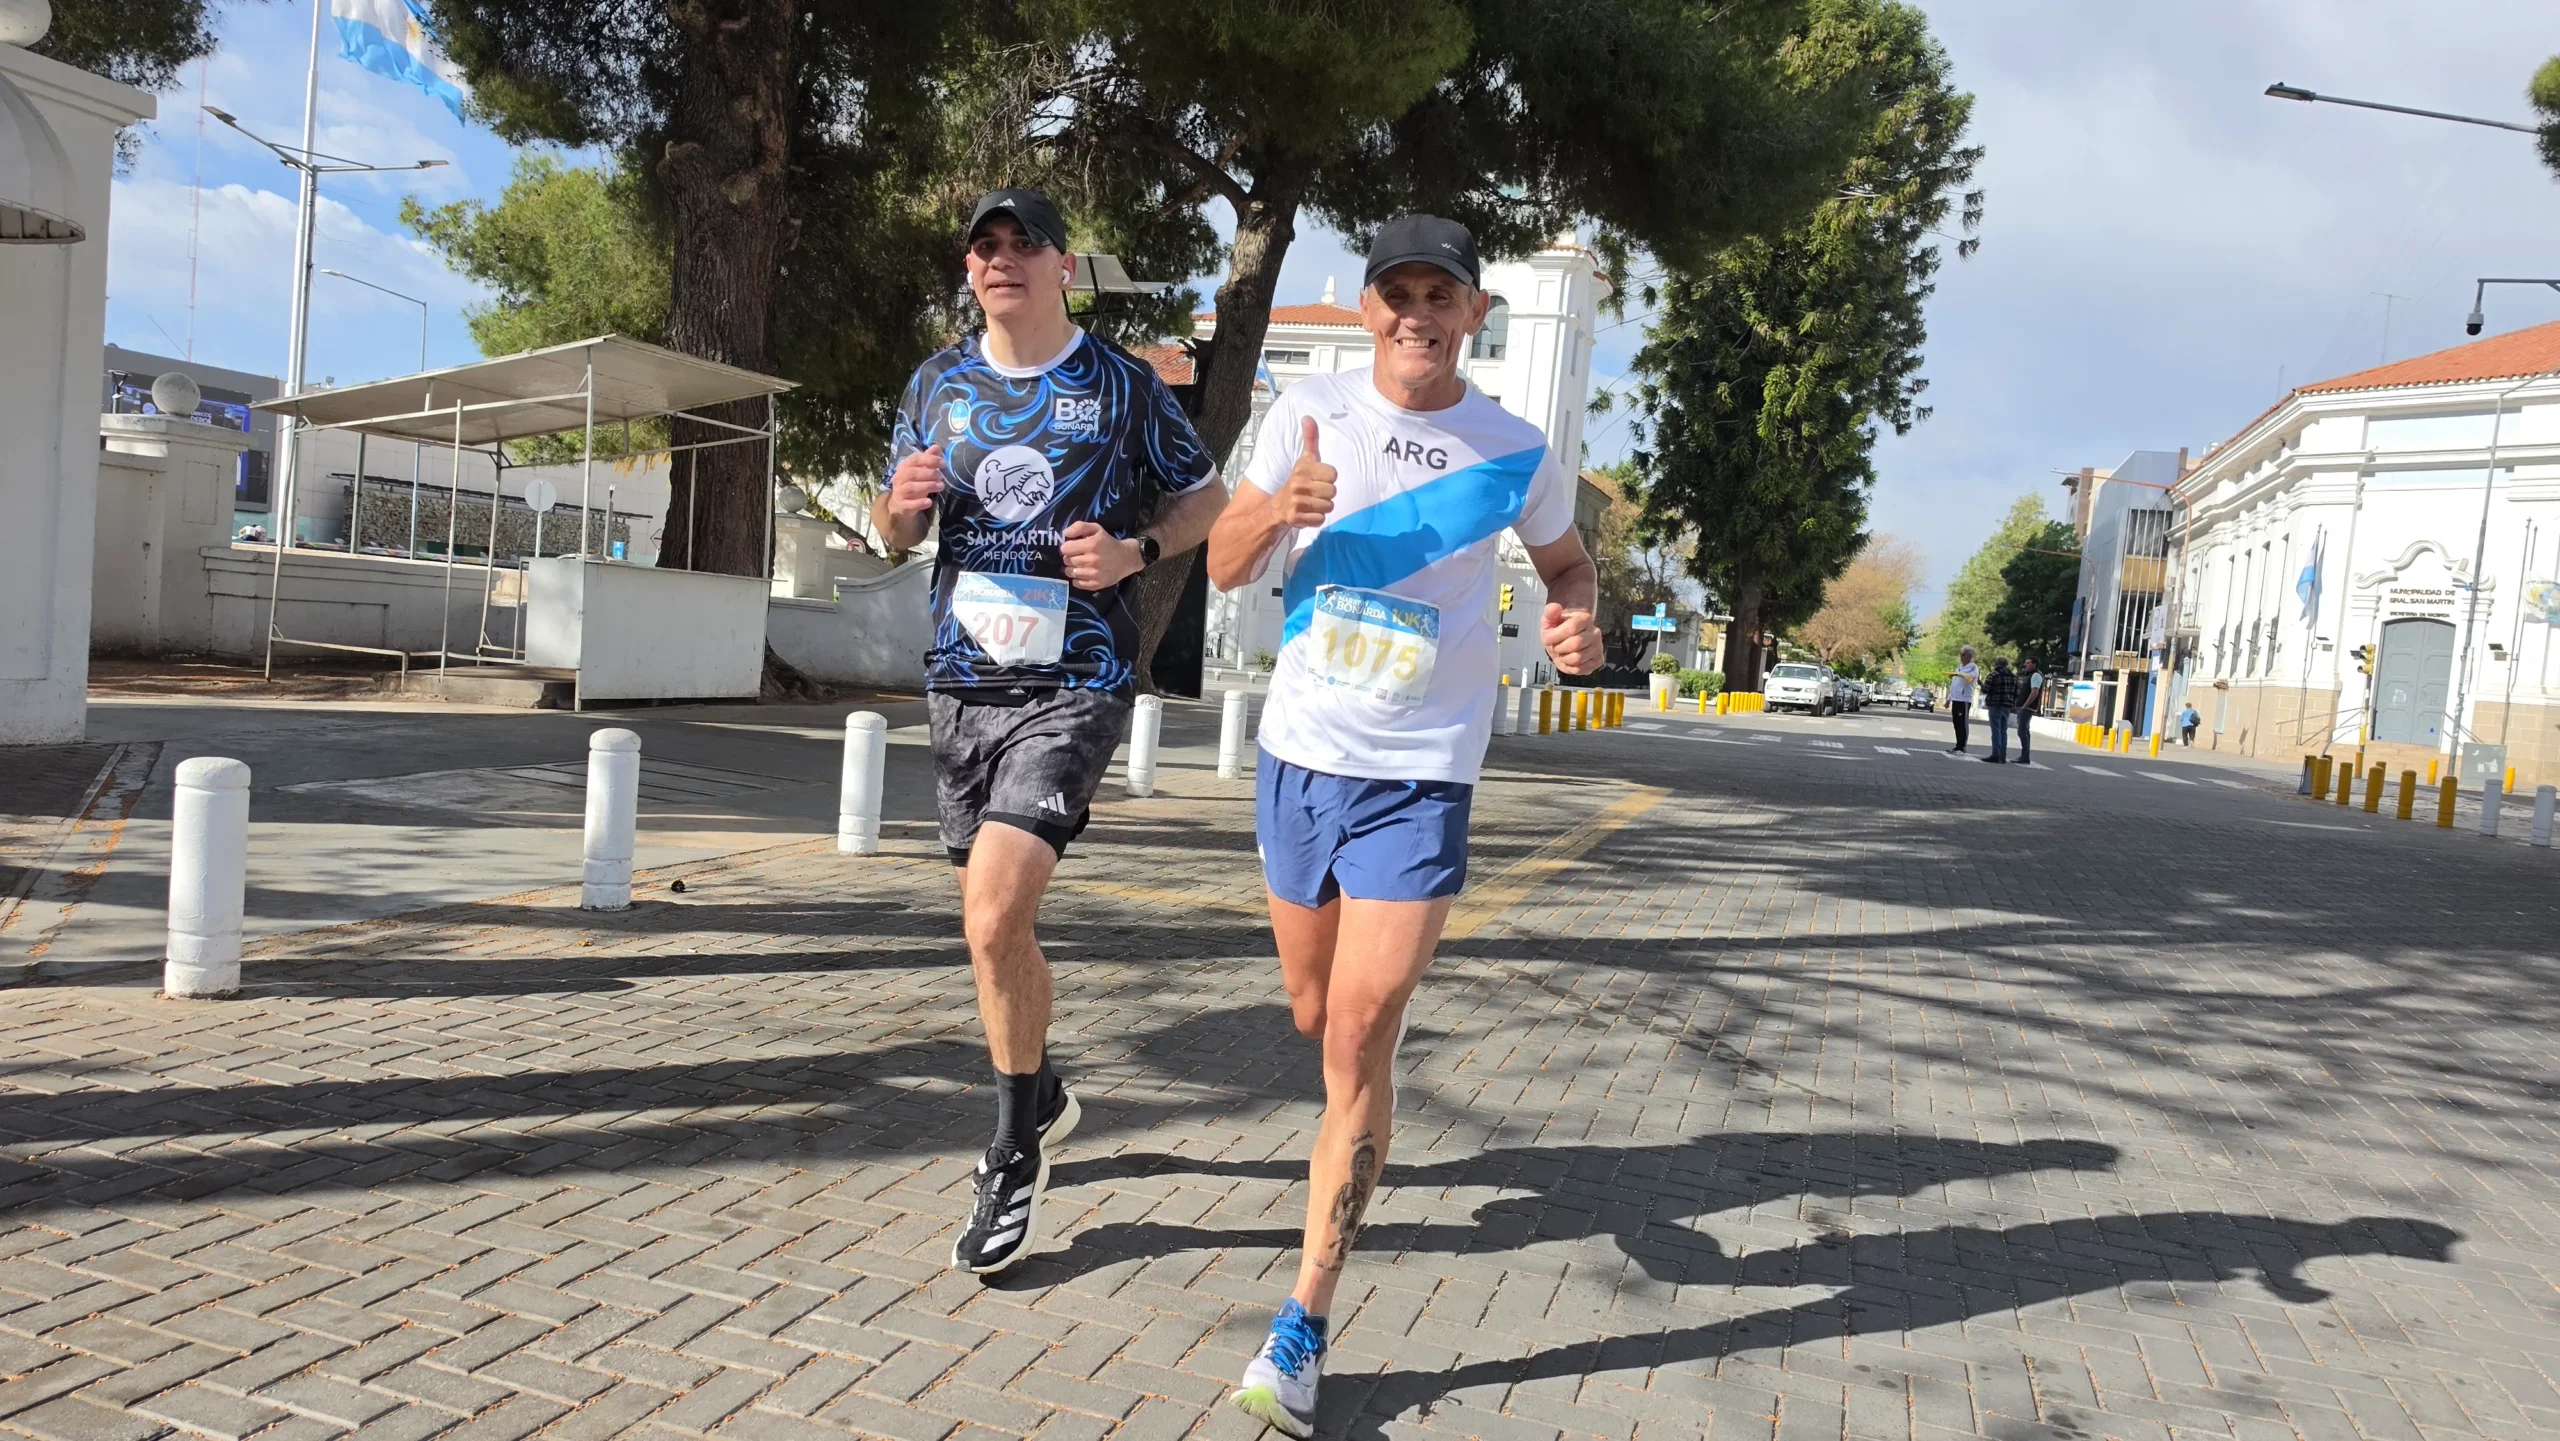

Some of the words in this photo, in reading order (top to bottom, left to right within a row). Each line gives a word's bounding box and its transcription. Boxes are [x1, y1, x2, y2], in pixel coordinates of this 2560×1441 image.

[1054, 422, 1099, 431] BONARDA
[1383, 436, 1448, 470] ARG
[967, 530, 996, 545] SAN
[1002, 526, 1064, 546] MARTÍN
[984, 551, 1042, 561] MENDOZA
[1336, 600, 1387, 620] BONARDA
[973, 611, 1040, 648] 207
[1323, 627, 1420, 681] 1075
